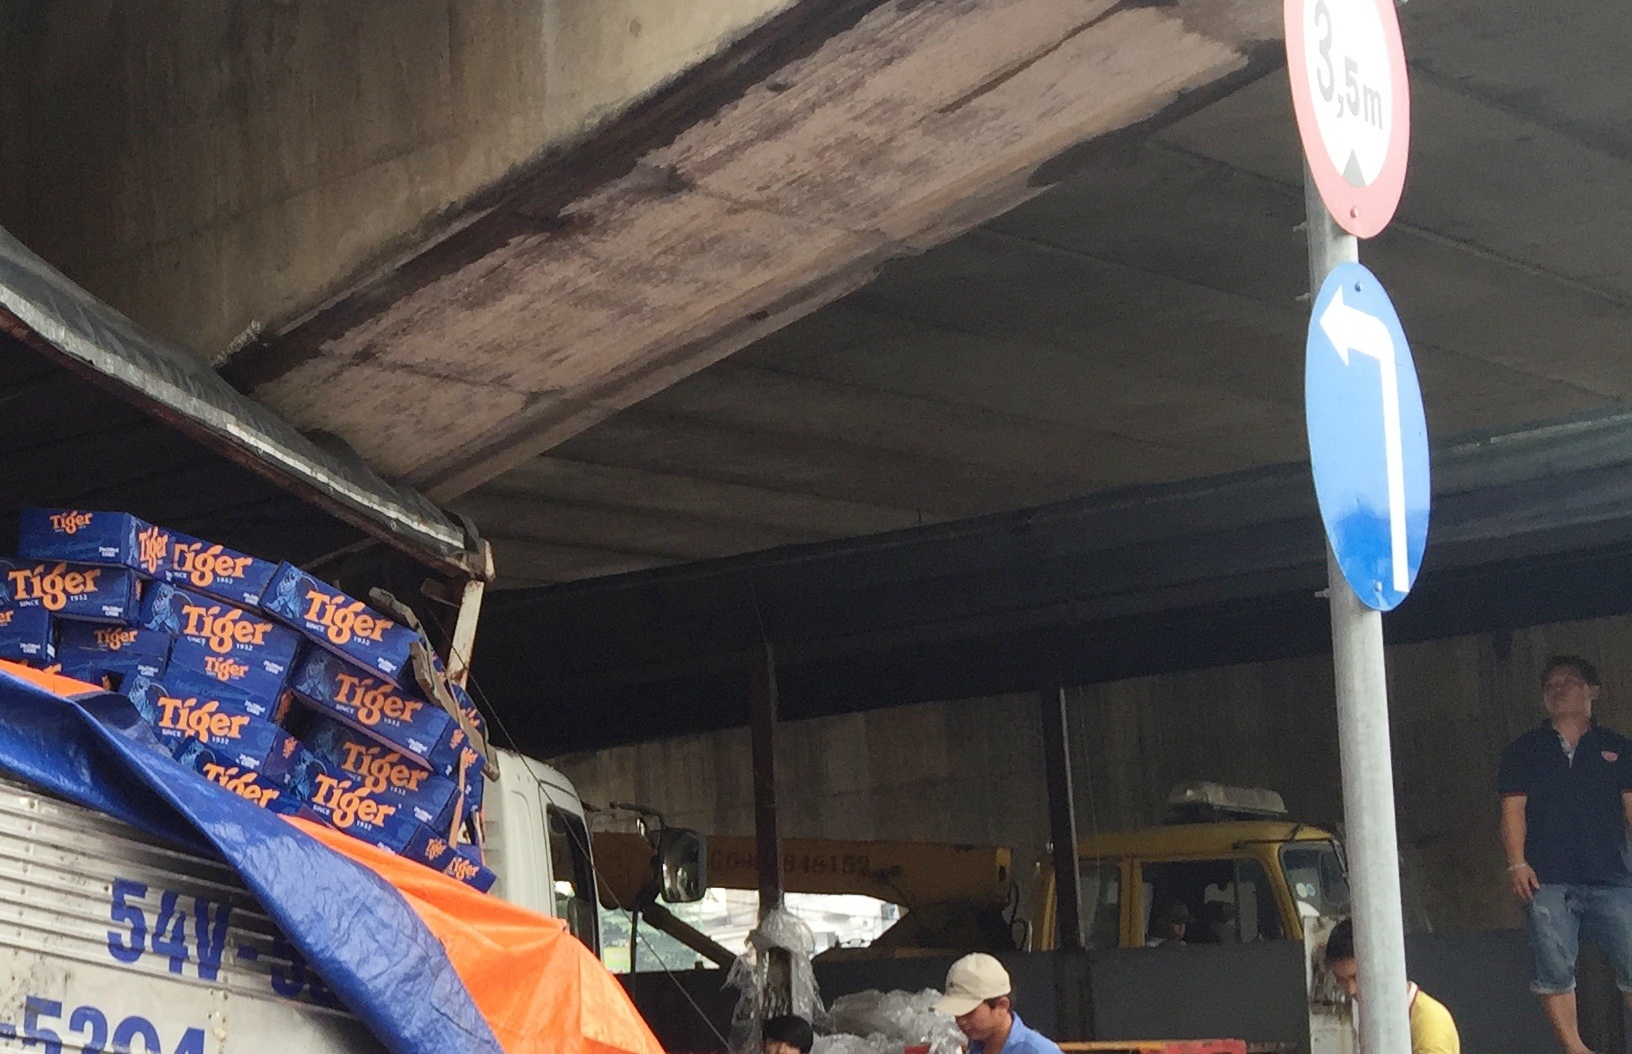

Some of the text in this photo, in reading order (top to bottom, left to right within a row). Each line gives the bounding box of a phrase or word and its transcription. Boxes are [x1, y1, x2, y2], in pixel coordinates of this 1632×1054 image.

[49, 510, 93, 534] Tiger
[8, 560, 101, 612] Tiger
[94, 627, 138, 650] Tiger
[182, 605, 273, 654] Tiger
[304, 589, 394, 645] Tiger
[204, 655, 249, 681] Tiger
[157, 696, 250, 744] Tiger
[334, 672, 423, 726] Tiger
[341, 741, 429, 794] Tiger
[311, 773, 396, 829] Tiger
